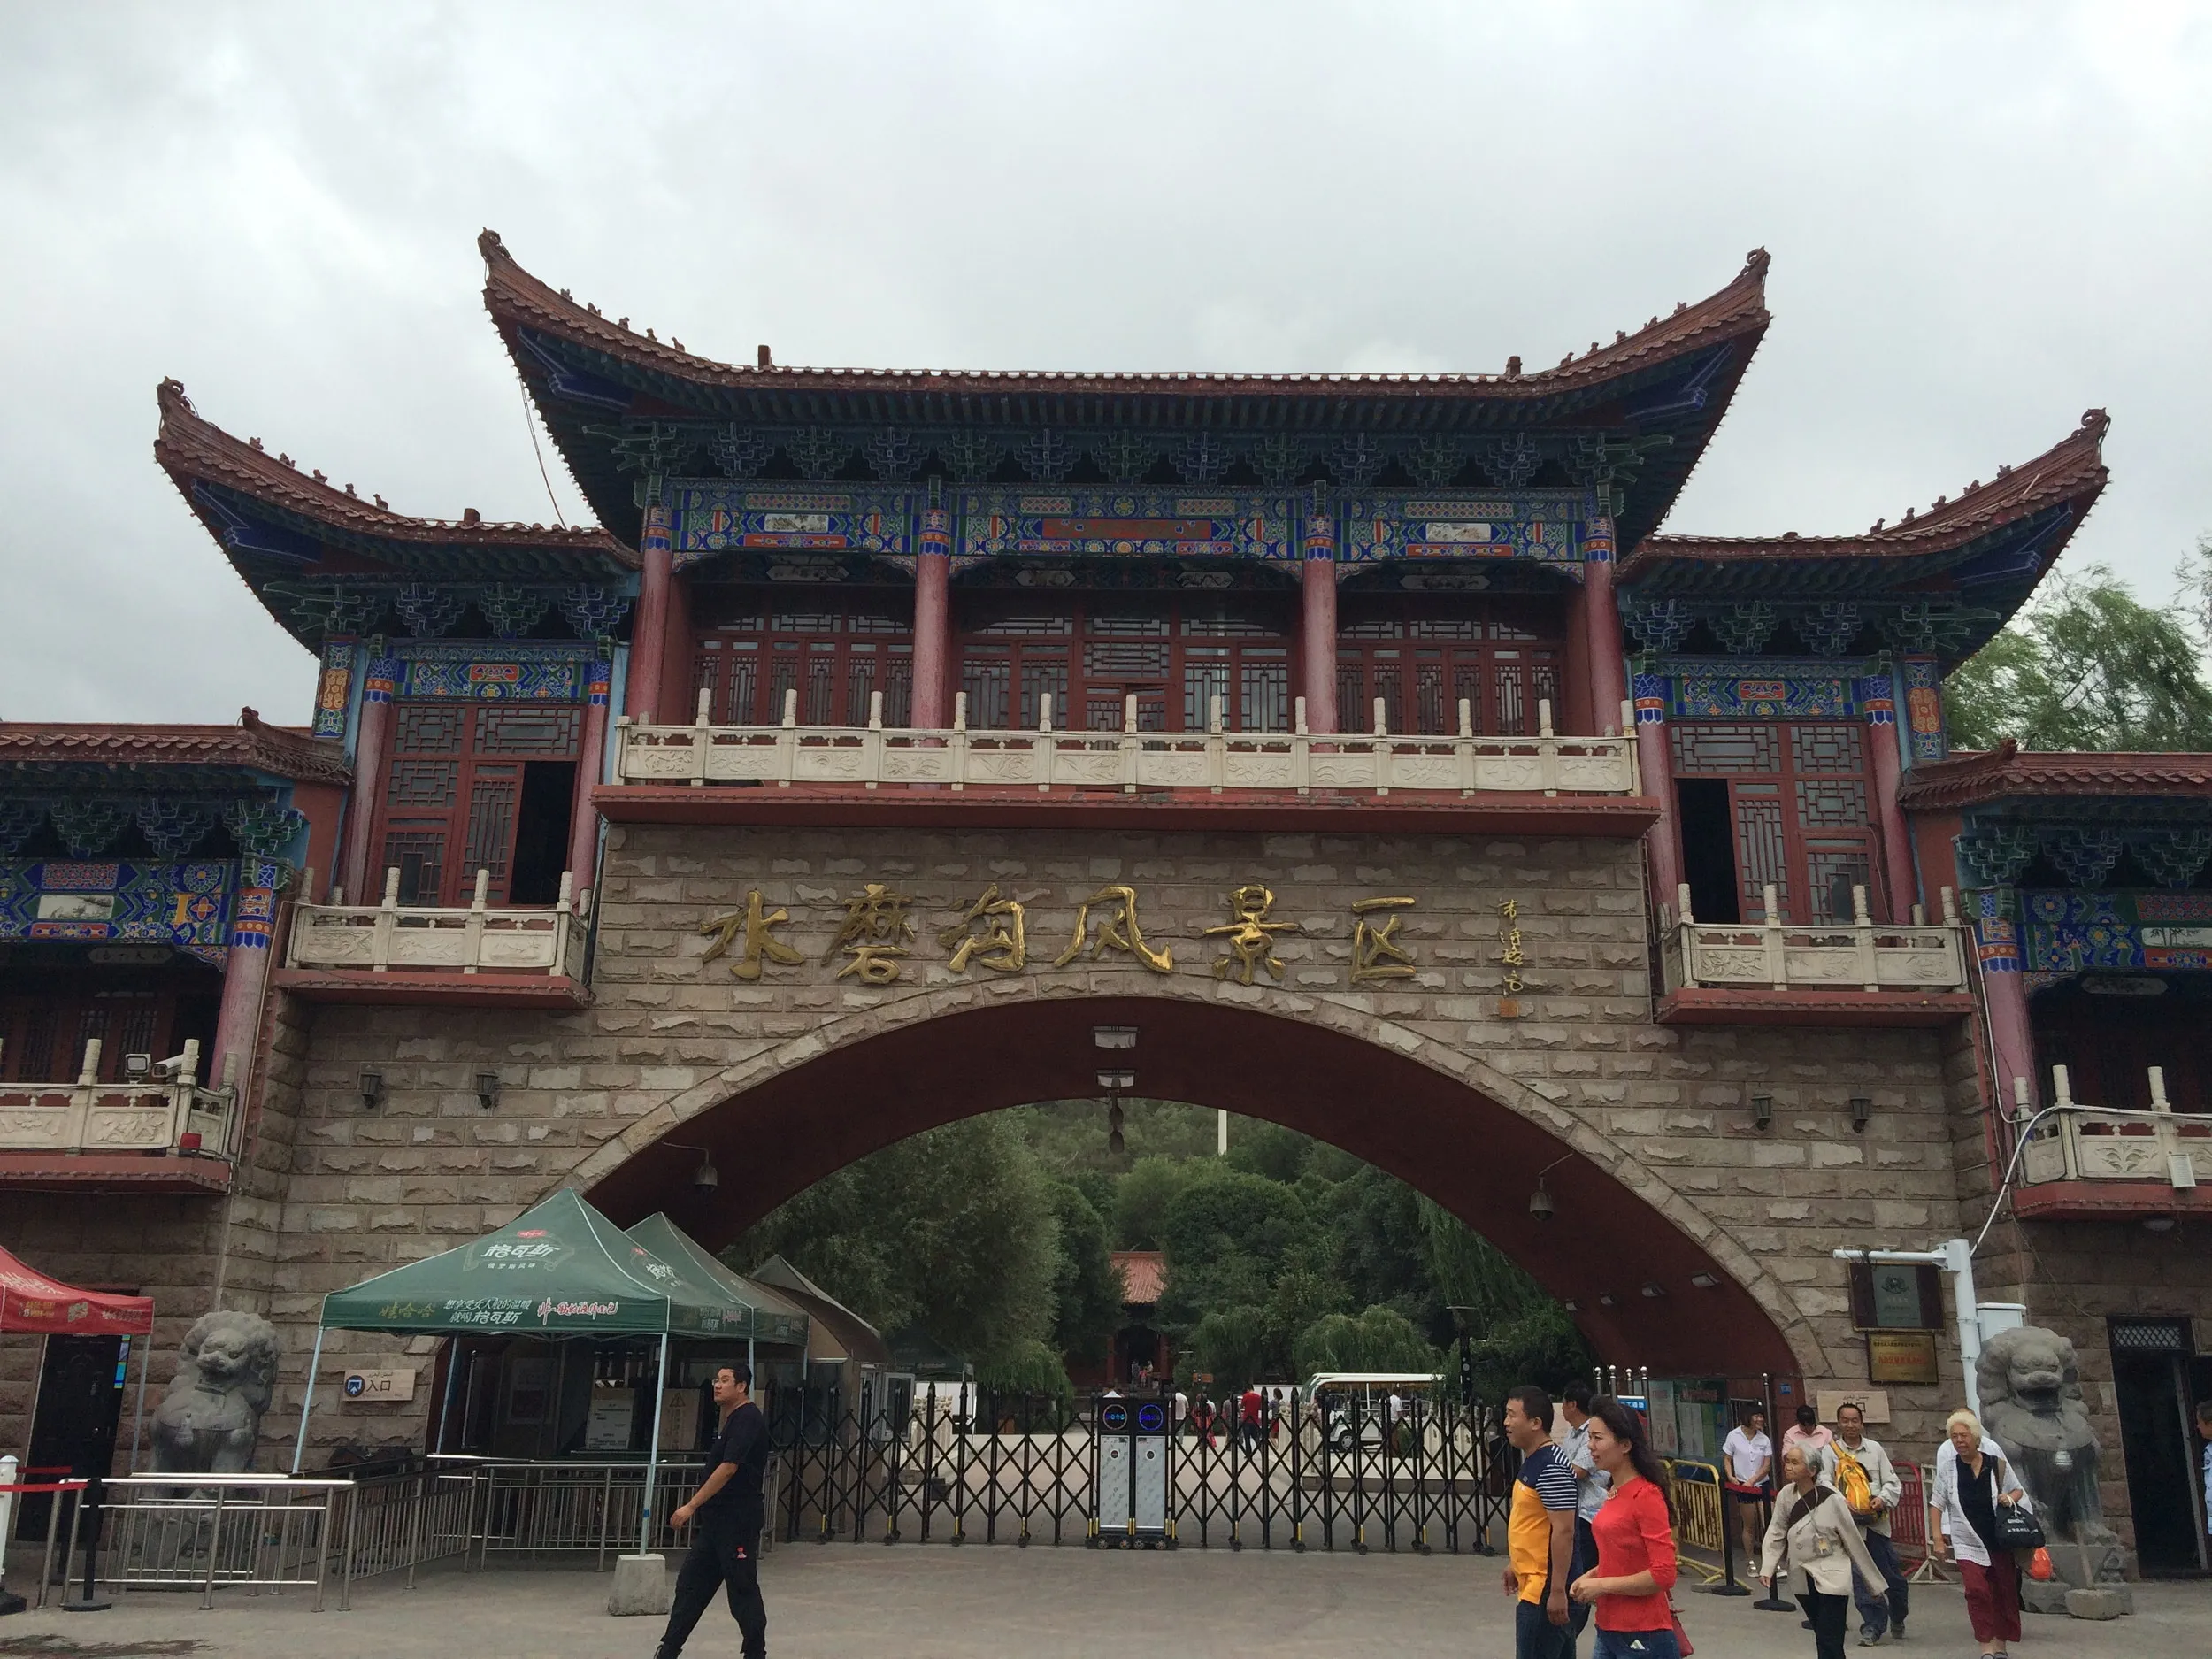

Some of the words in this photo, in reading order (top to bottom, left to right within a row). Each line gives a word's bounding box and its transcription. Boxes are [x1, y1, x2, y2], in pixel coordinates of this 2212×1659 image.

[700, 883, 1417, 986] 水磨沟风景区
[480, 1243, 561, 1258] 格瓦斯
[379, 1302, 435, 1319] 娃哈哈
[366, 1380, 391, 1393] 入口
